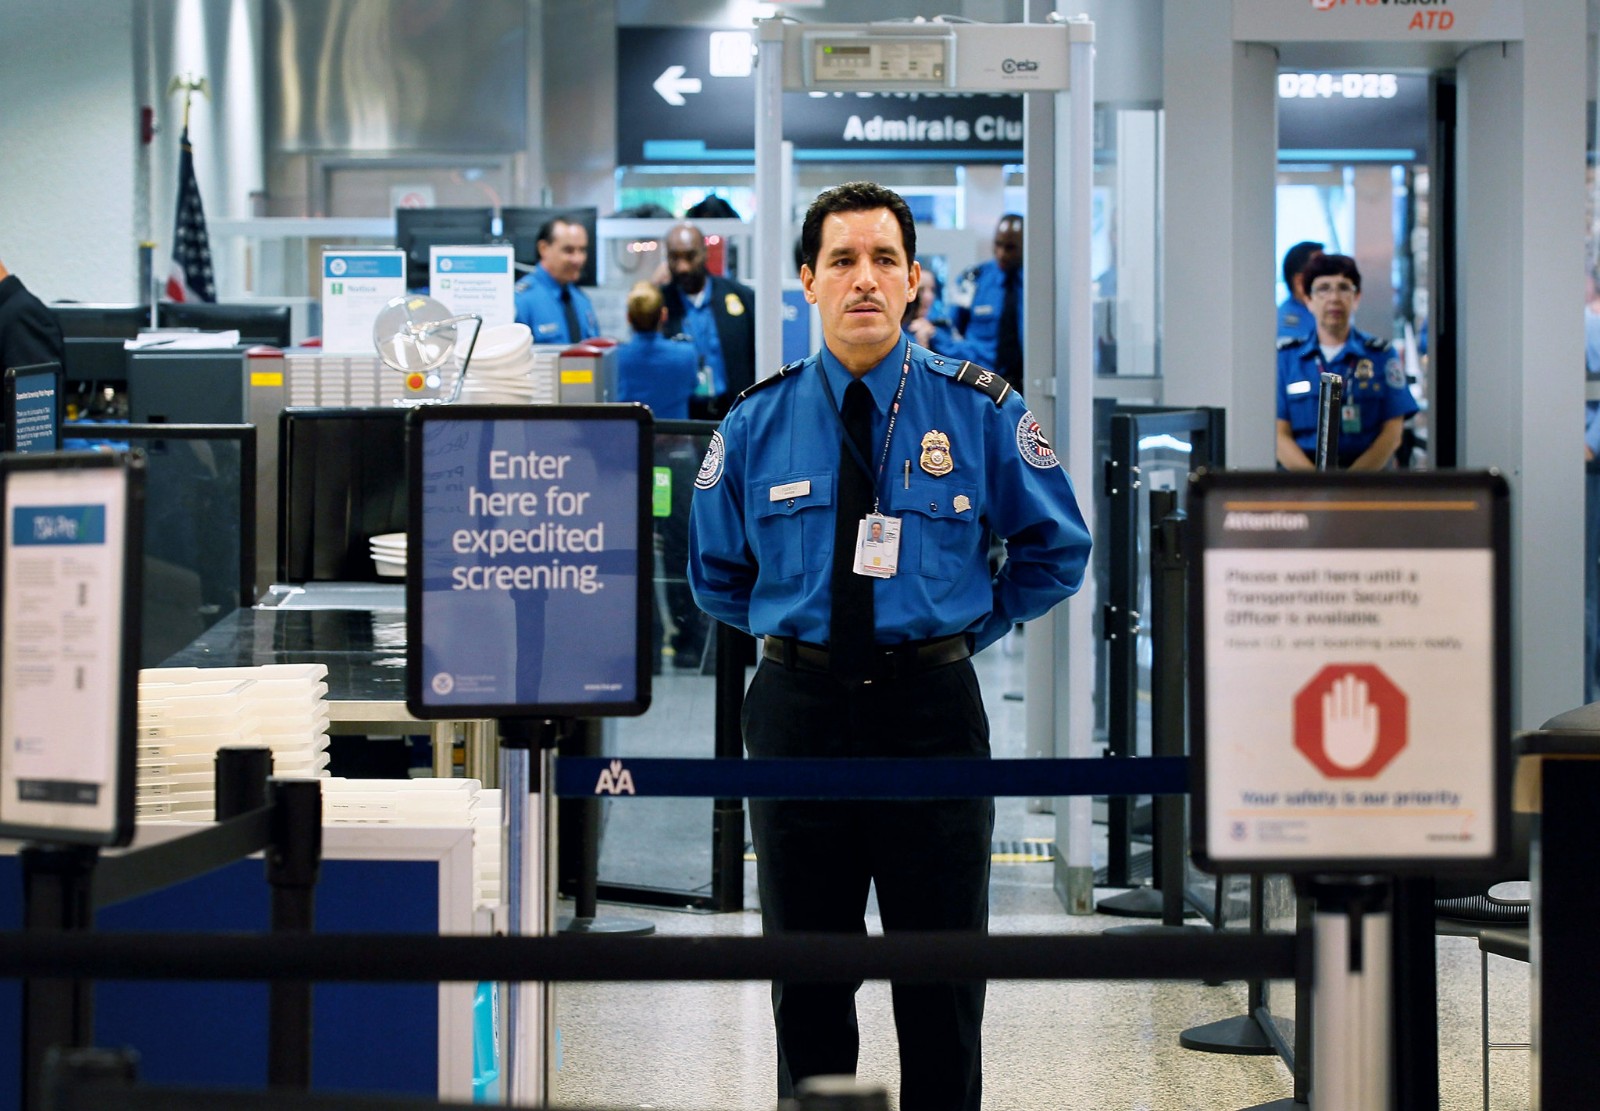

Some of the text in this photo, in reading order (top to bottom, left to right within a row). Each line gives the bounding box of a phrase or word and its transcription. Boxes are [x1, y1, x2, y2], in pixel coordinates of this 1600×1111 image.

[1408, 10, 1455, 31] ATD
[1278, 73, 1398, 98] D24-D25
[843, 115, 1022, 141] Admirals Clu
[975, 370, 995, 388] TSA
[489, 450, 571, 480] Enter
[469, 486, 591, 516] here for
[1223, 511, 1309, 530] Attention
[452, 522, 604, 558] expedited
[452, 559, 604, 594] screening.
[1225, 570, 1278, 583] Please
[1285, 570, 1318, 583] wait
[1324, 569, 1360, 583] here
[1366, 569, 1402, 583] until
[1226, 589, 1419, 608] Transportation Security
[1225, 610, 1280, 625] Officer
[1241, 790, 1460, 810] Your safety is our priority
